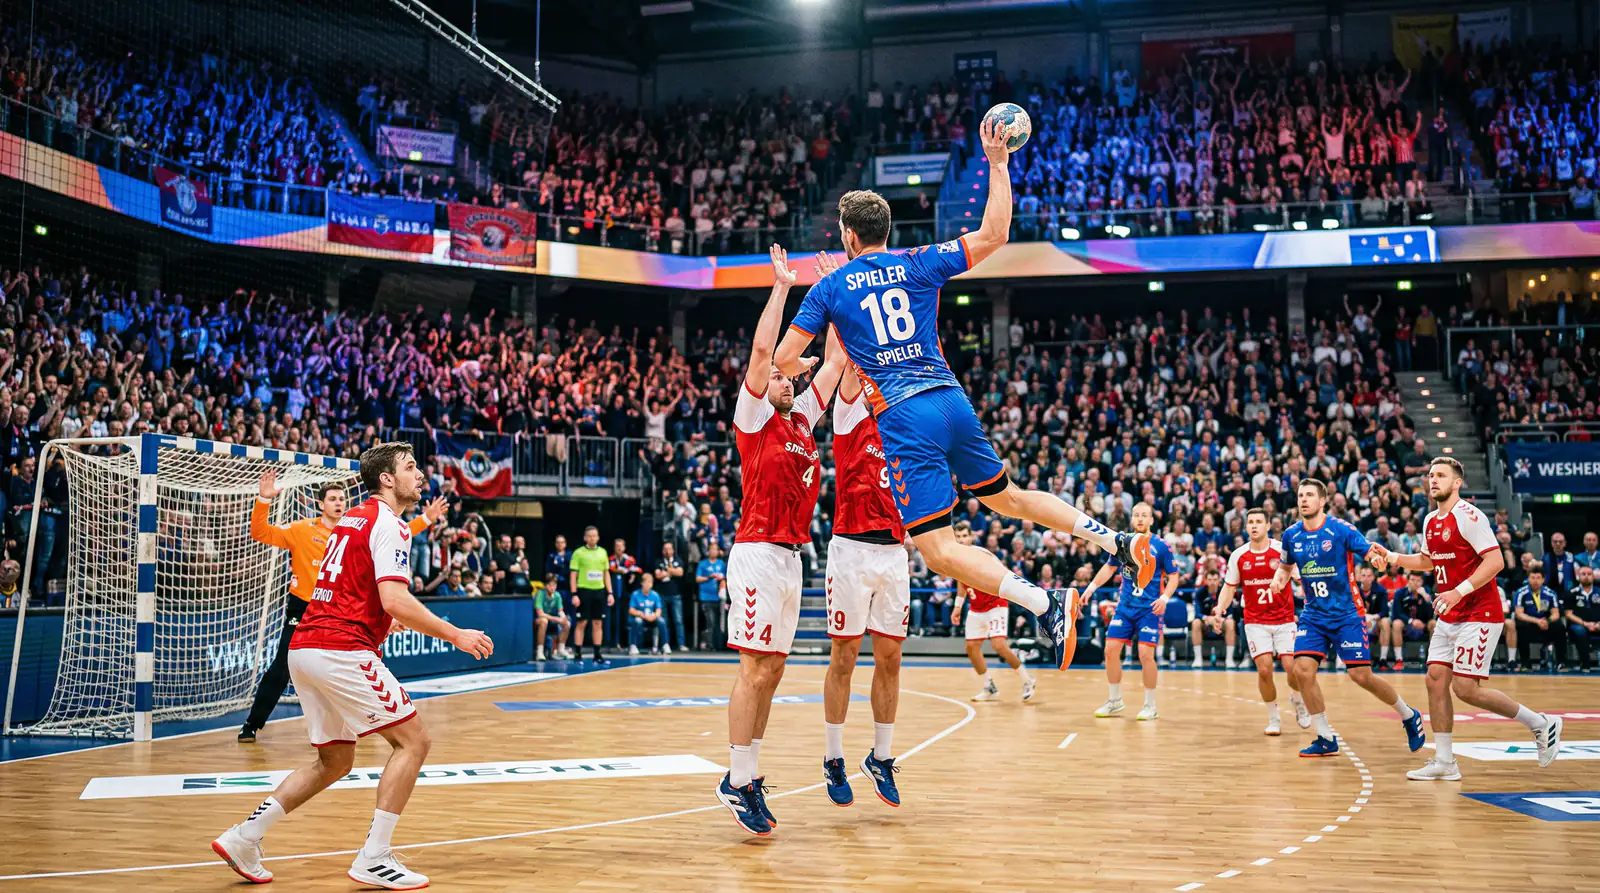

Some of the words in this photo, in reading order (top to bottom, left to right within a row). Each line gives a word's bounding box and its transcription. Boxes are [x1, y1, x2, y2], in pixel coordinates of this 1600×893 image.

[846, 265, 907, 290] SPIELER
[860, 288, 916, 346] 18
[876, 343, 923, 366] SPIELER
[802, 465, 815, 488] 4
[879, 466, 891, 488] 9
[317, 533, 350, 583] 24
[1435, 565, 1448, 584] 21
[1257, 588, 1273, 604] 21
[1311, 581, 1329, 598] 18
[834, 610, 846, 631] 9
[759, 624, 772, 646] 4
[1455, 646, 1474, 665] 21
